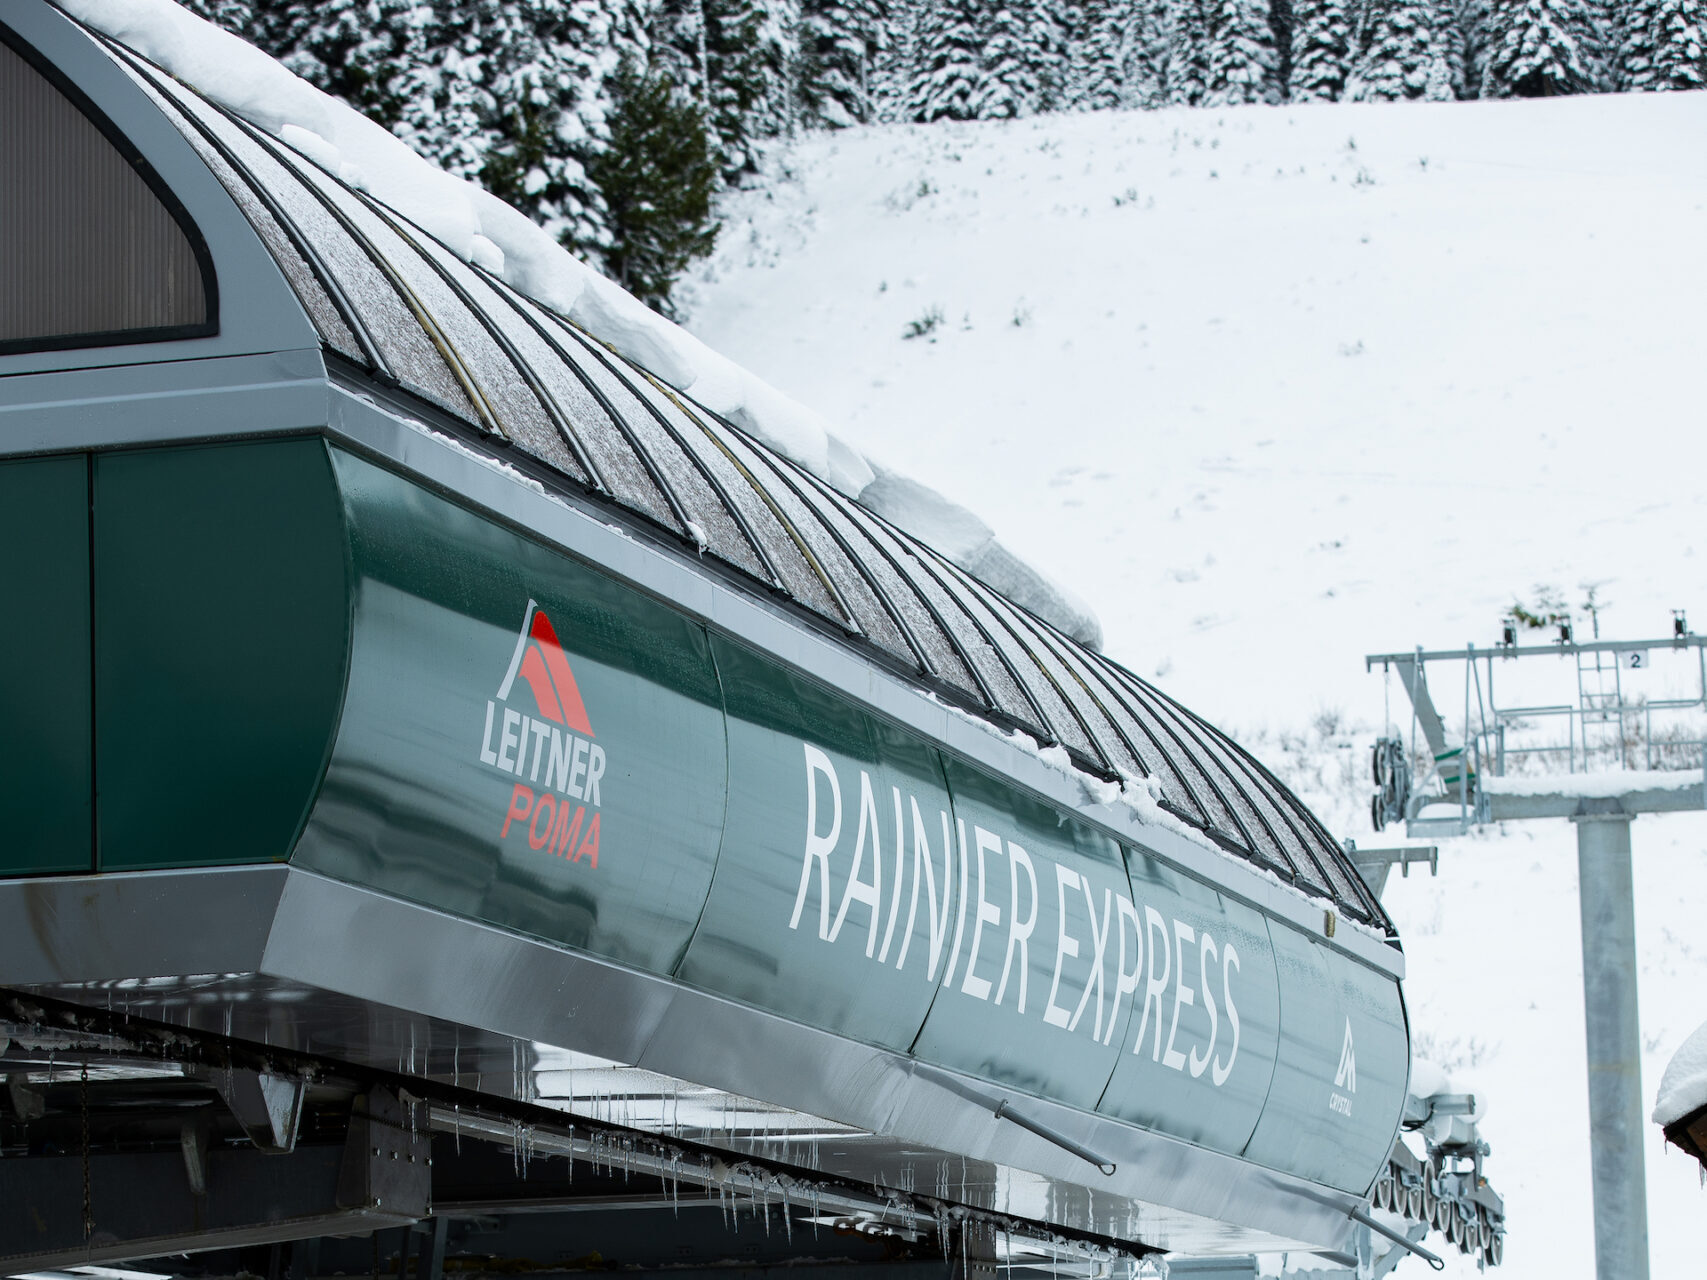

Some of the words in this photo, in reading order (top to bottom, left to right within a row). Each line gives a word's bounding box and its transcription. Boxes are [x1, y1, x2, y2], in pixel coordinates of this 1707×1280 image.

[1631, 654, 1641, 668] 2
[480, 700, 606, 807] LEITNER
[500, 783, 600, 869] POMA
[789, 743, 1038, 1014] RAINIER
[1043, 863, 1240, 1086] EXPRESS
[1329, 1092, 1352, 1117] CRYSTAL
